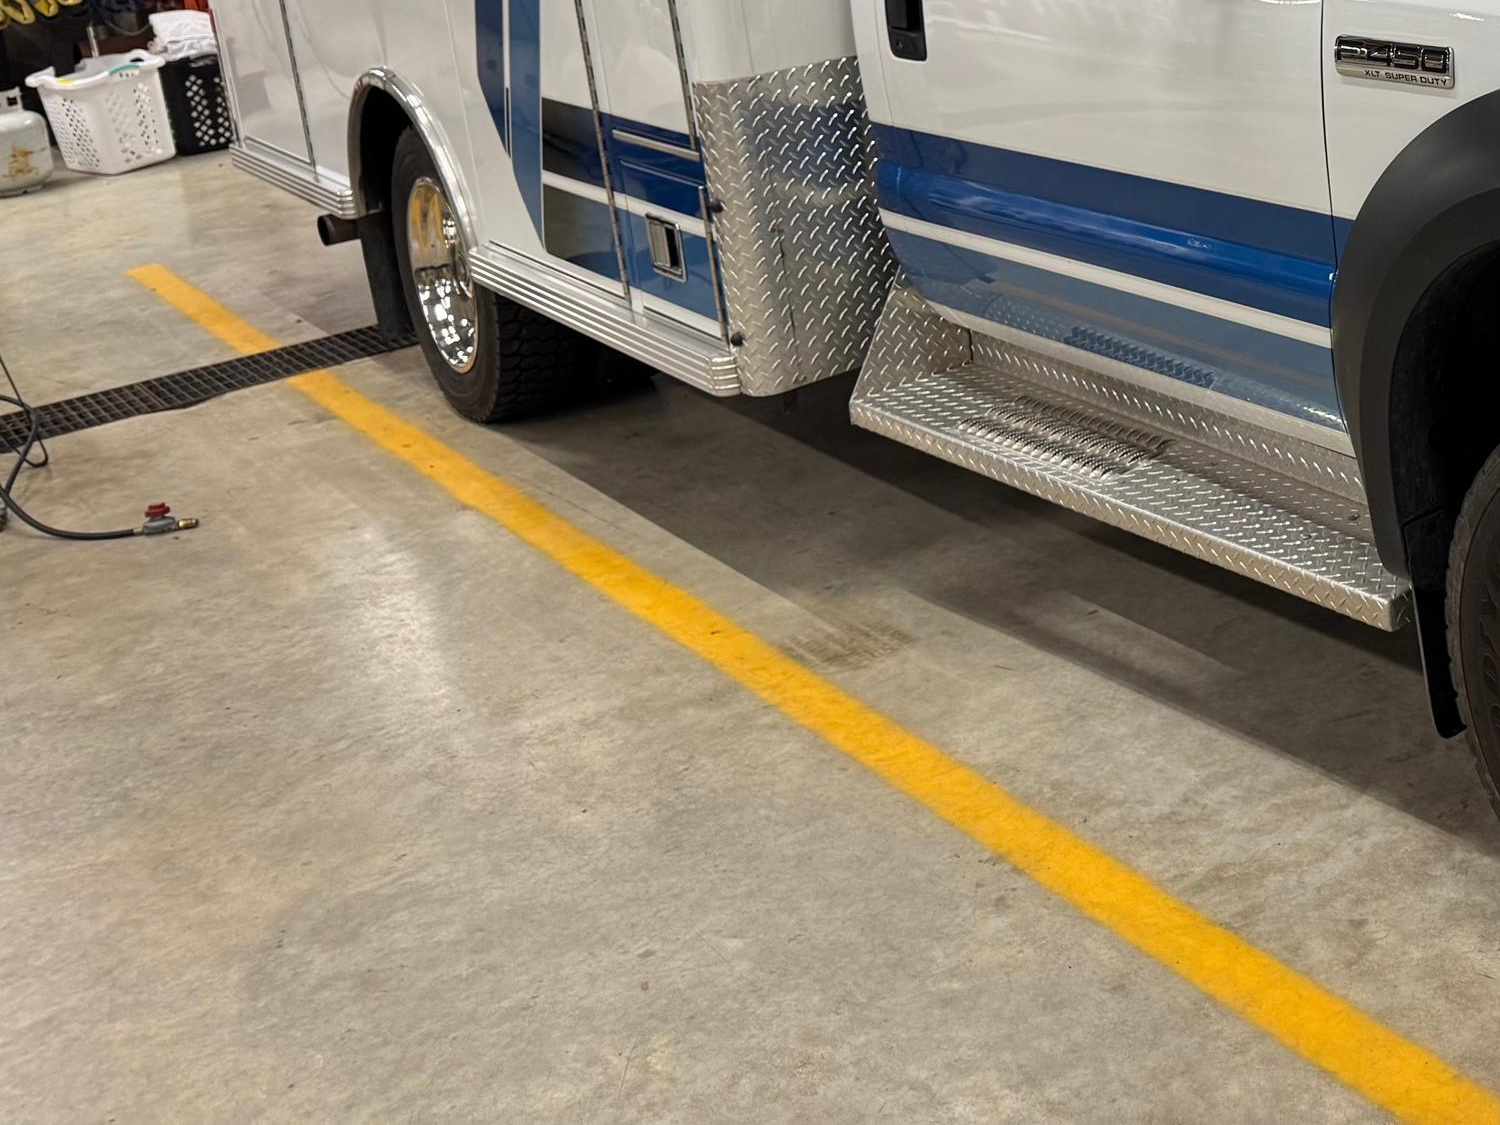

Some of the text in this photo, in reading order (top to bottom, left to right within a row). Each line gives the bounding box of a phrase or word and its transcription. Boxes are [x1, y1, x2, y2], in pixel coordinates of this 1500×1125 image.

[1365, 69, 1448, 87] XLT SUPER DUTY
